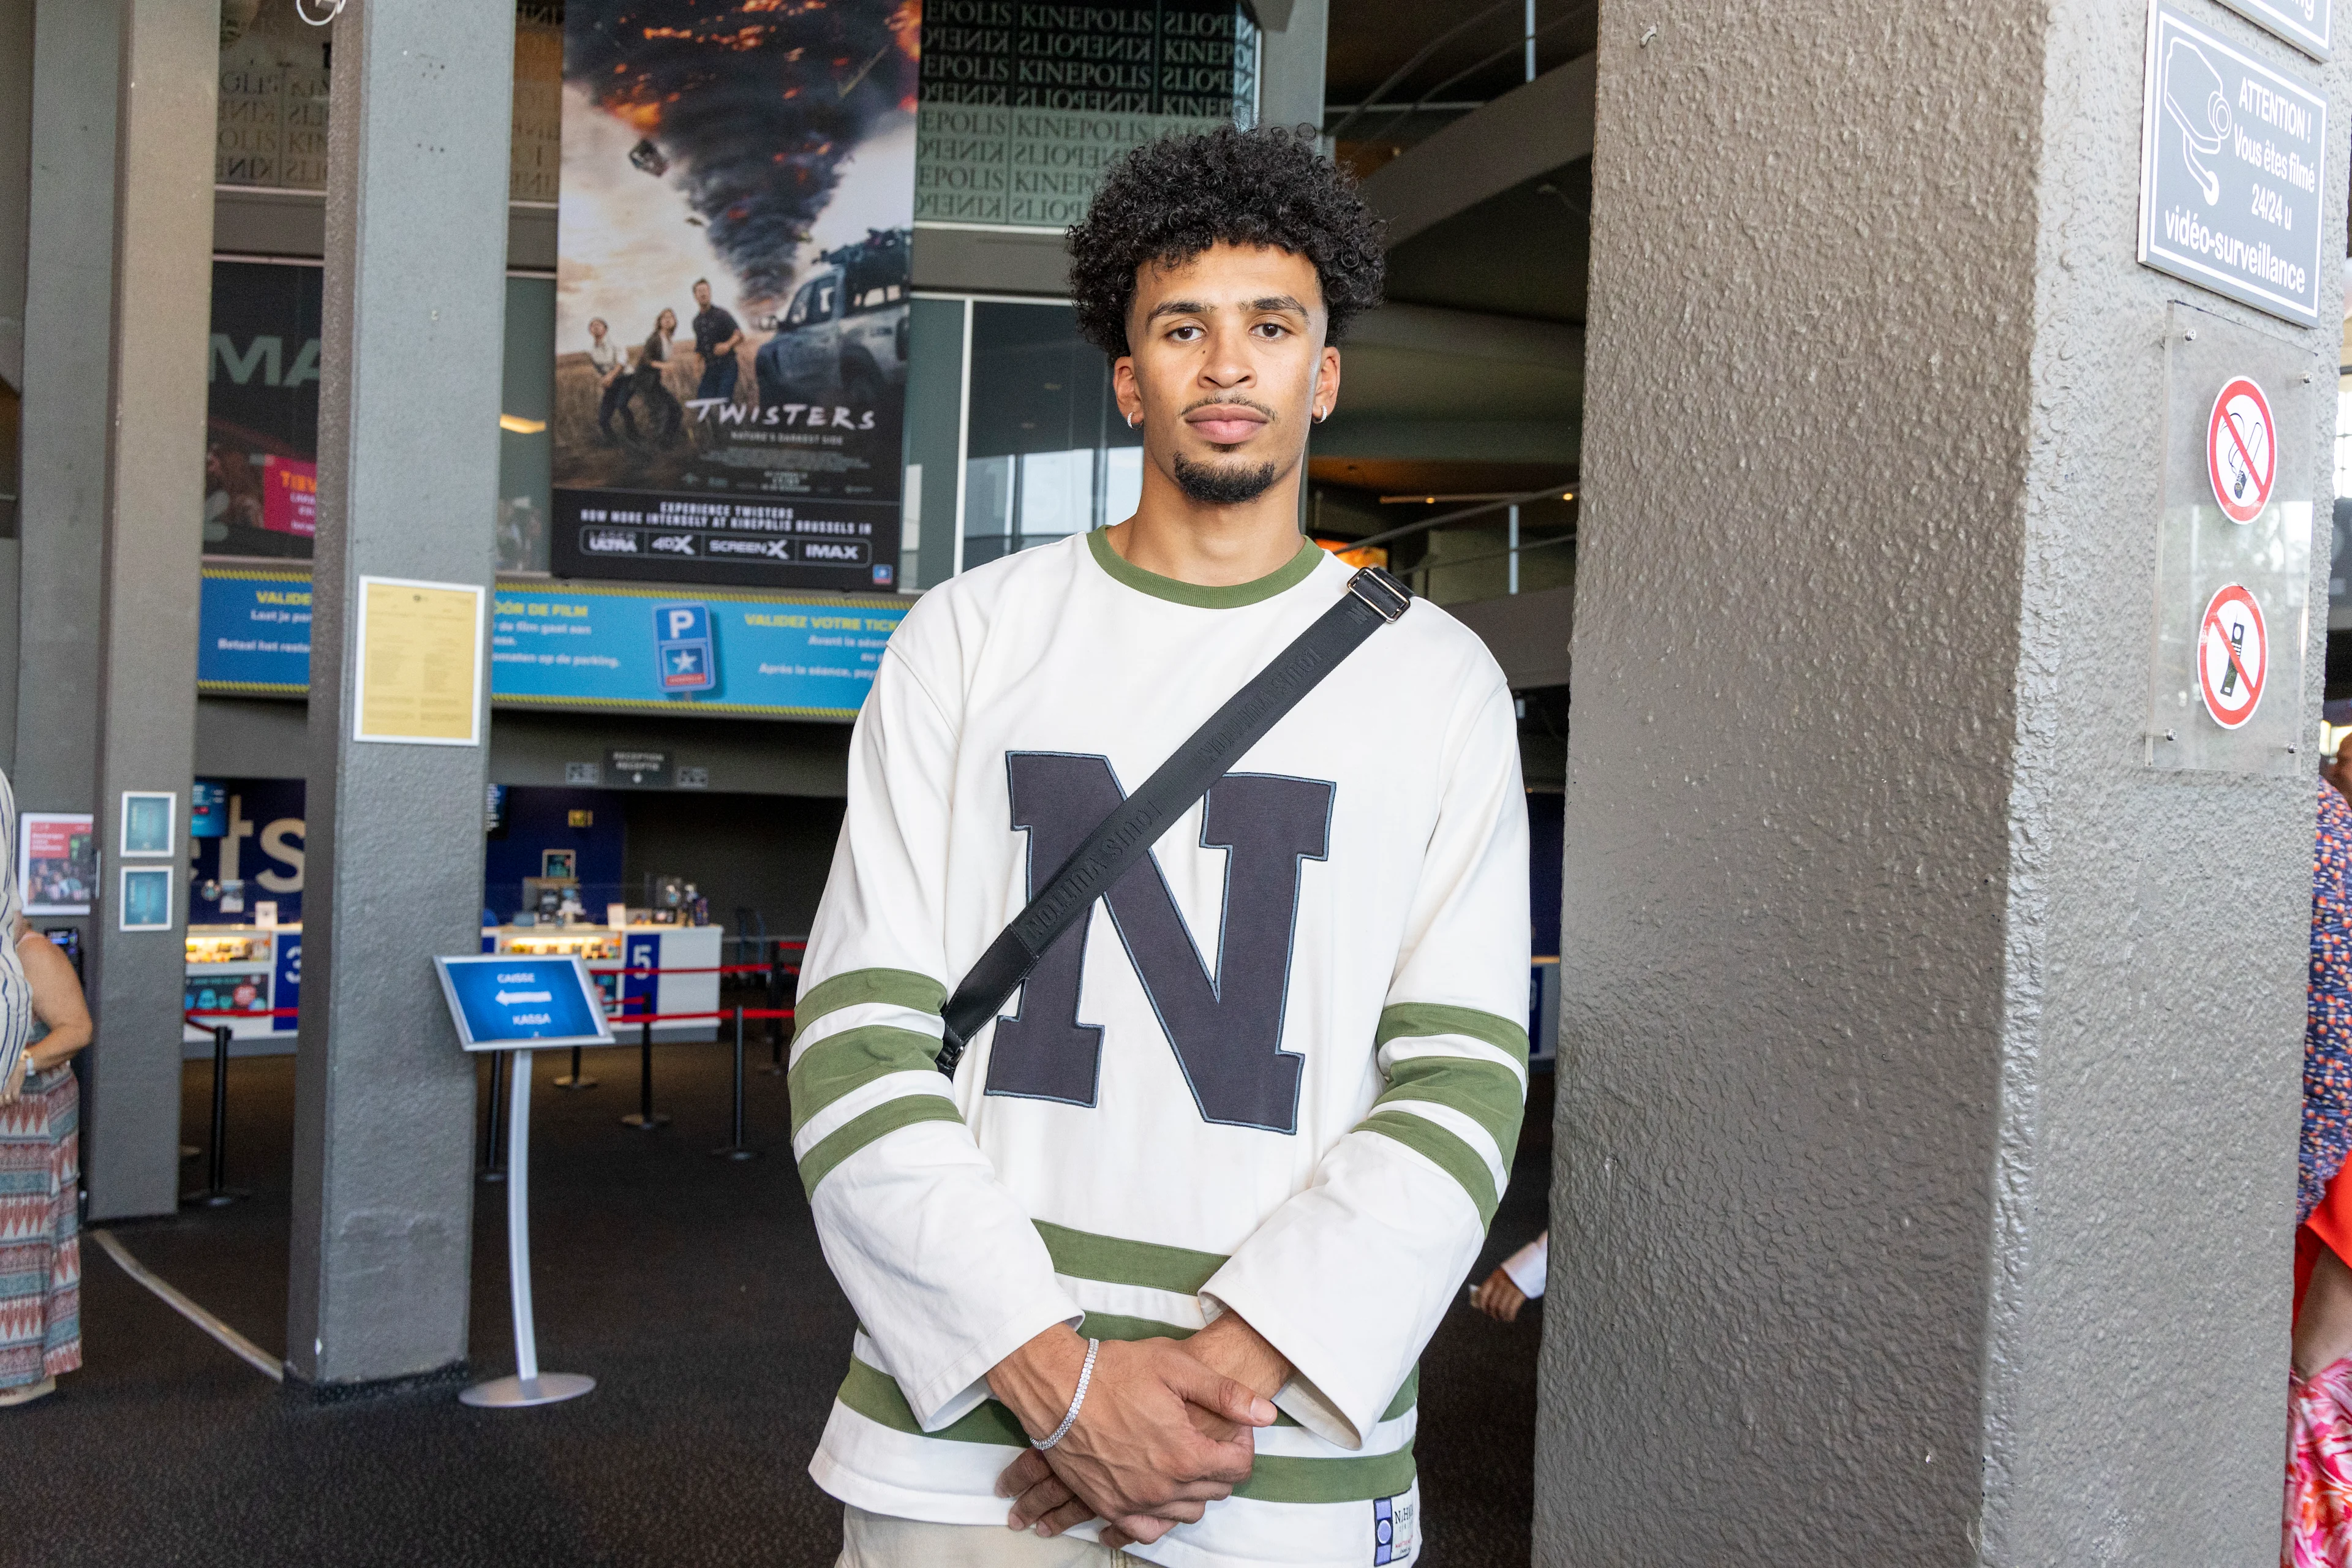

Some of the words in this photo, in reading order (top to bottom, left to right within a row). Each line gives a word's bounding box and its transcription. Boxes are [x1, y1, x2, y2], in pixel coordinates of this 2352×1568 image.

[1020, 4, 1154, 32] KINEPOLIS
[1019, 59, 1152, 89] KINEPOLIS
[2239, 76, 2305, 138] ATTENTION
[2307, 112, 2312, 145] !
[1017, 114, 1152, 142] KINEPOLIS
[2234, 123, 2262, 168] Vous
[2263, 142, 2288, 182] êtes
[2288, 151, 2315, 194] filmé
[2251, 183, 2283, 225] 24/24
[2285, 207, 2293, 232] u
[2165, 205, 2305, 295] vidéo-surveillance
[684, 397, 875, 430] TWISTERS
[610, 510, 643, 525] MORE
[646, 511, 708, 527] INTENSELY
[730, 516, 792, 532] KINEPOLIS
[796, 519, 855, 535] BRUSSELS
[859, 522, 872, 535] IN
[660, 501, 731, 518] EXPERIENCE
[734, 505, 794, 520] TWISTERS
[589, 537, 638, 552] ULTRA
[651, 535, 696, 556] 4DX
[805, 543, 859, 560] IMAX
[527, 603, 548, 616] DE
[552, 604, 588, 617] FILM
[669, 609, 695, 639] P
[744, 614, 807, 629] VALIDEZ
[810, 617, 861, 631] VOTRE
[983, 749, 1338, 1134] N
[632, 944, 652, 979] 5
[497, 973, 535, 984] CAISSE
[512, 1013, 552, 1025] KASSA
